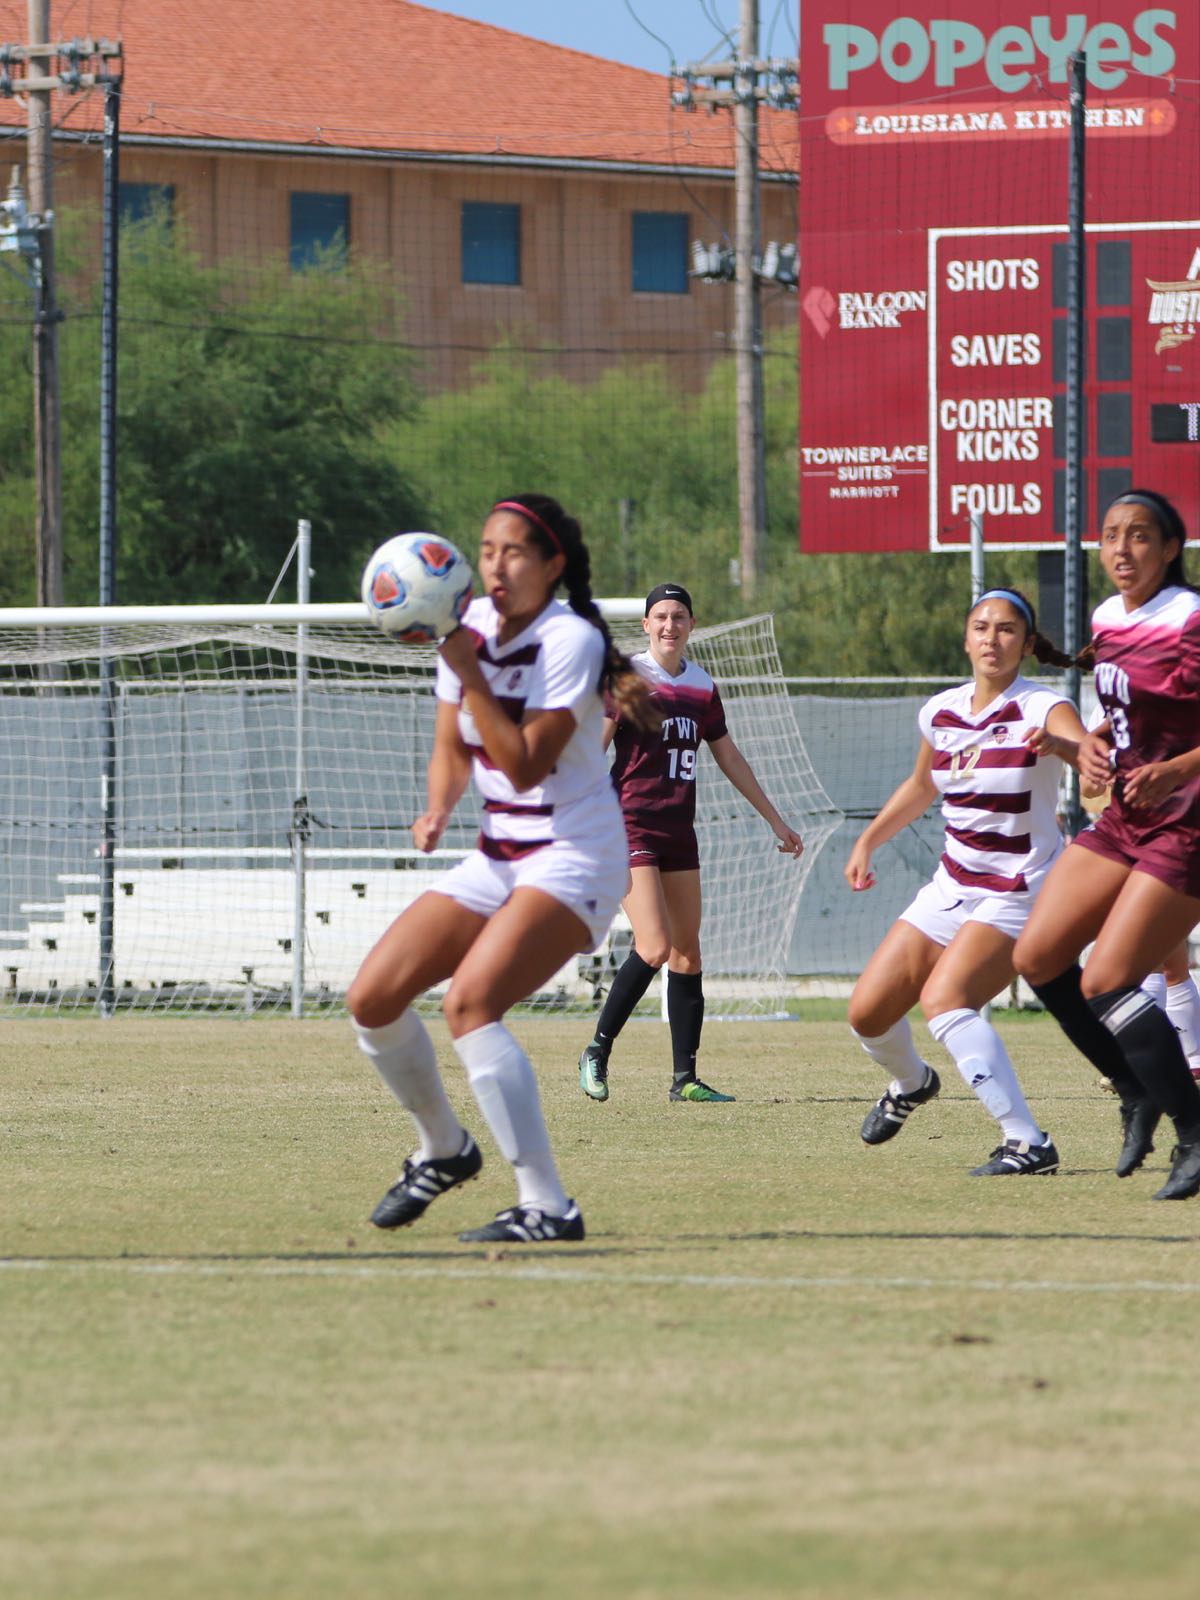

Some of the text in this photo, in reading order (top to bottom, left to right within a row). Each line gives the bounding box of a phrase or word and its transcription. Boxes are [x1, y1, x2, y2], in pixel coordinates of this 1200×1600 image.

[855, 108, 1144, 135] LOUISIANA KITHEN
[946, 258, 1040, 292] SHOTS
[838, 291, 927, 311] FALCON
[839, 310, 901, 329] BANK
[951, 333, 1041, 367] SAVES
[940, 397, 1054, 431] CORNER
[801, 445, 928, 465] TOWNEPLACE
[956, 430, 1039, 462] KICKS
[837, 465, 893, 481] SUITES
[829, 485, 899, 499] MARRIOTT
[950, 482, 1042, 516] FOULS
[667, 748, 696, 780] 19
